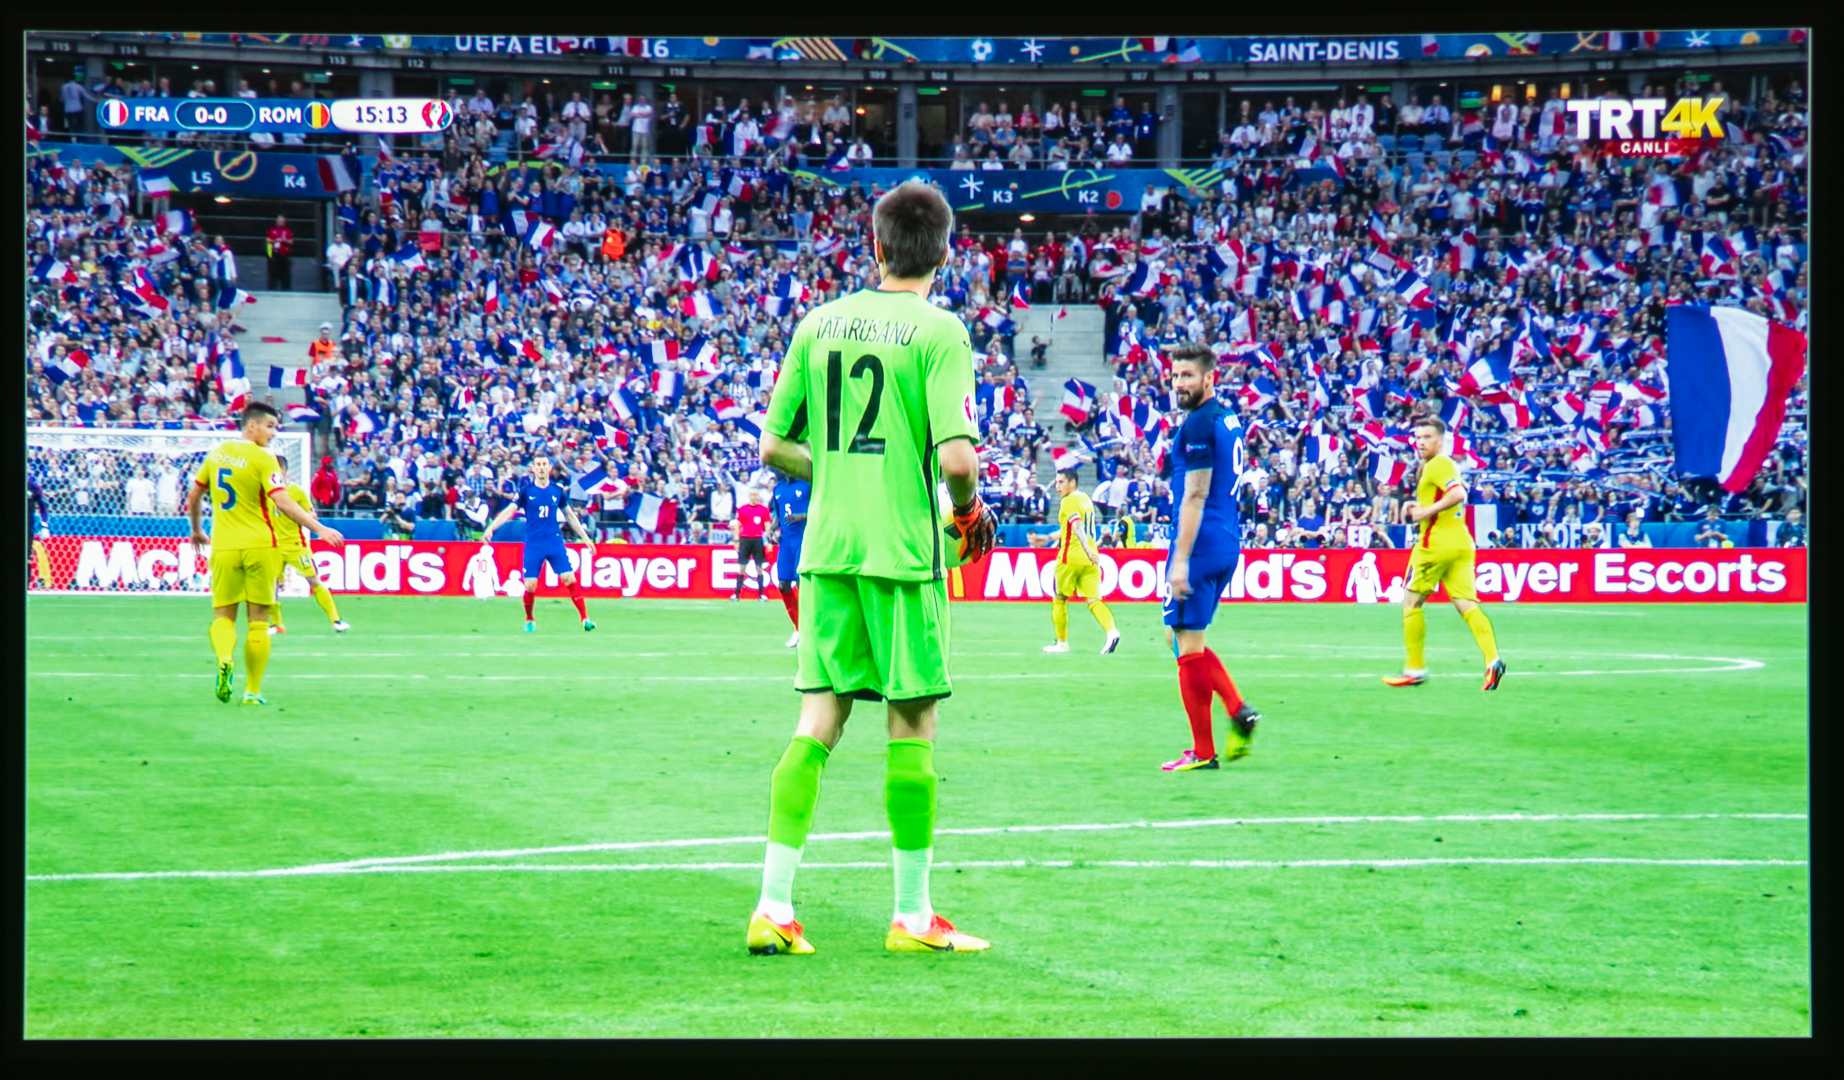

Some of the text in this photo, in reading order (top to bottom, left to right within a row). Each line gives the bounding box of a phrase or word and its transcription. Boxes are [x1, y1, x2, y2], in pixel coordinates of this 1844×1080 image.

[455, 35, 523, 54] UEFA
[1249, 40, 1400, 62] SAINT-DENIS
[406, 58, 426, 68] 112
[134, 106, 408, 124] FRA 0-0 ROM 15:13
[1620, 141, 1670, 154] CANLI
[191, 169, 213, 185] L5
[283, 174, 307, 189] K4
[993, 189, 1014, 203] K3
[1078, 190, 1100, 203] K2
[816, 317, 917, 347] TATARUSANU
[827, 350, 886, 456] 12
[218, 467, 237, 511] 5
[538, 505, 550, 518] 21
[75, 541, 447, 593] McDald's
[1593, 552, 1787, 594] Escorts
[1164, 581, 1173, 607] 9
